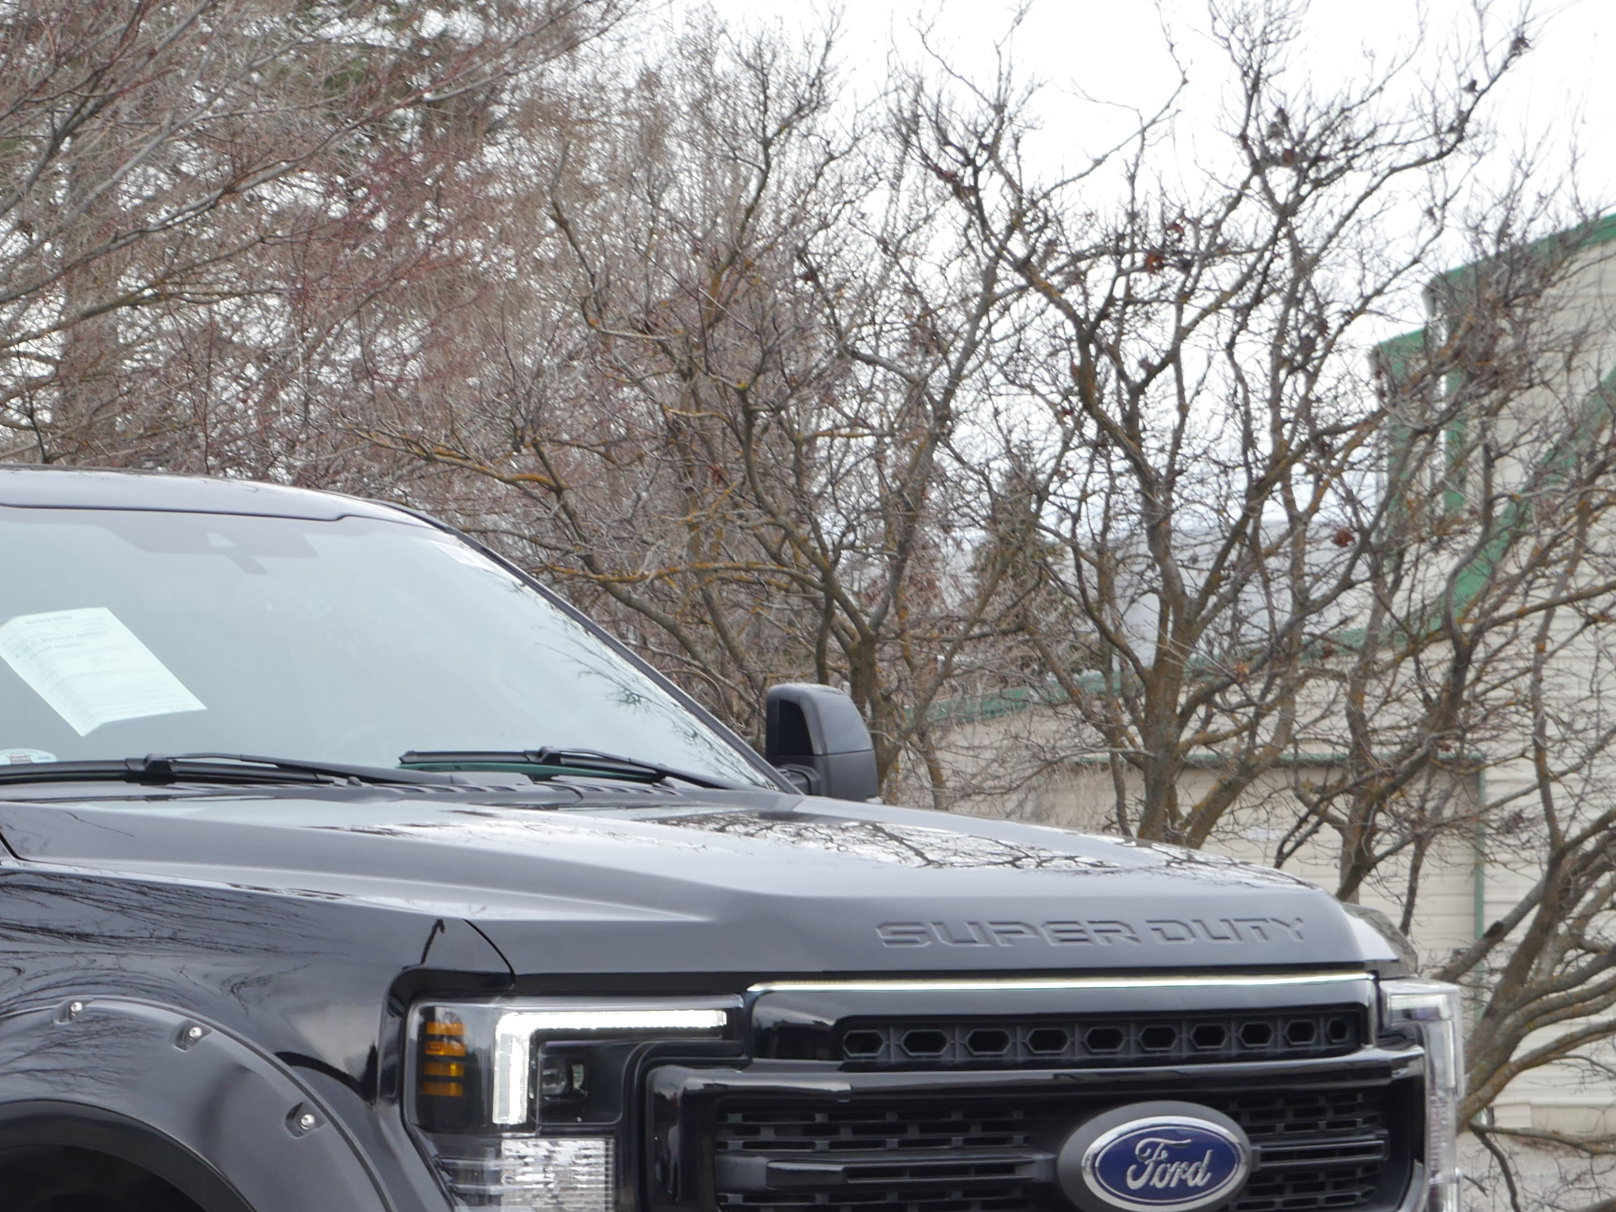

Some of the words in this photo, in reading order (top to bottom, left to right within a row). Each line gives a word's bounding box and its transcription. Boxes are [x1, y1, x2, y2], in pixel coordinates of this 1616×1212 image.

[875, 919, 1142, 948] SUPER
[1144, 917, 1304, 945] DUTY
[1126, 1137, 1212, 1190] Ford
